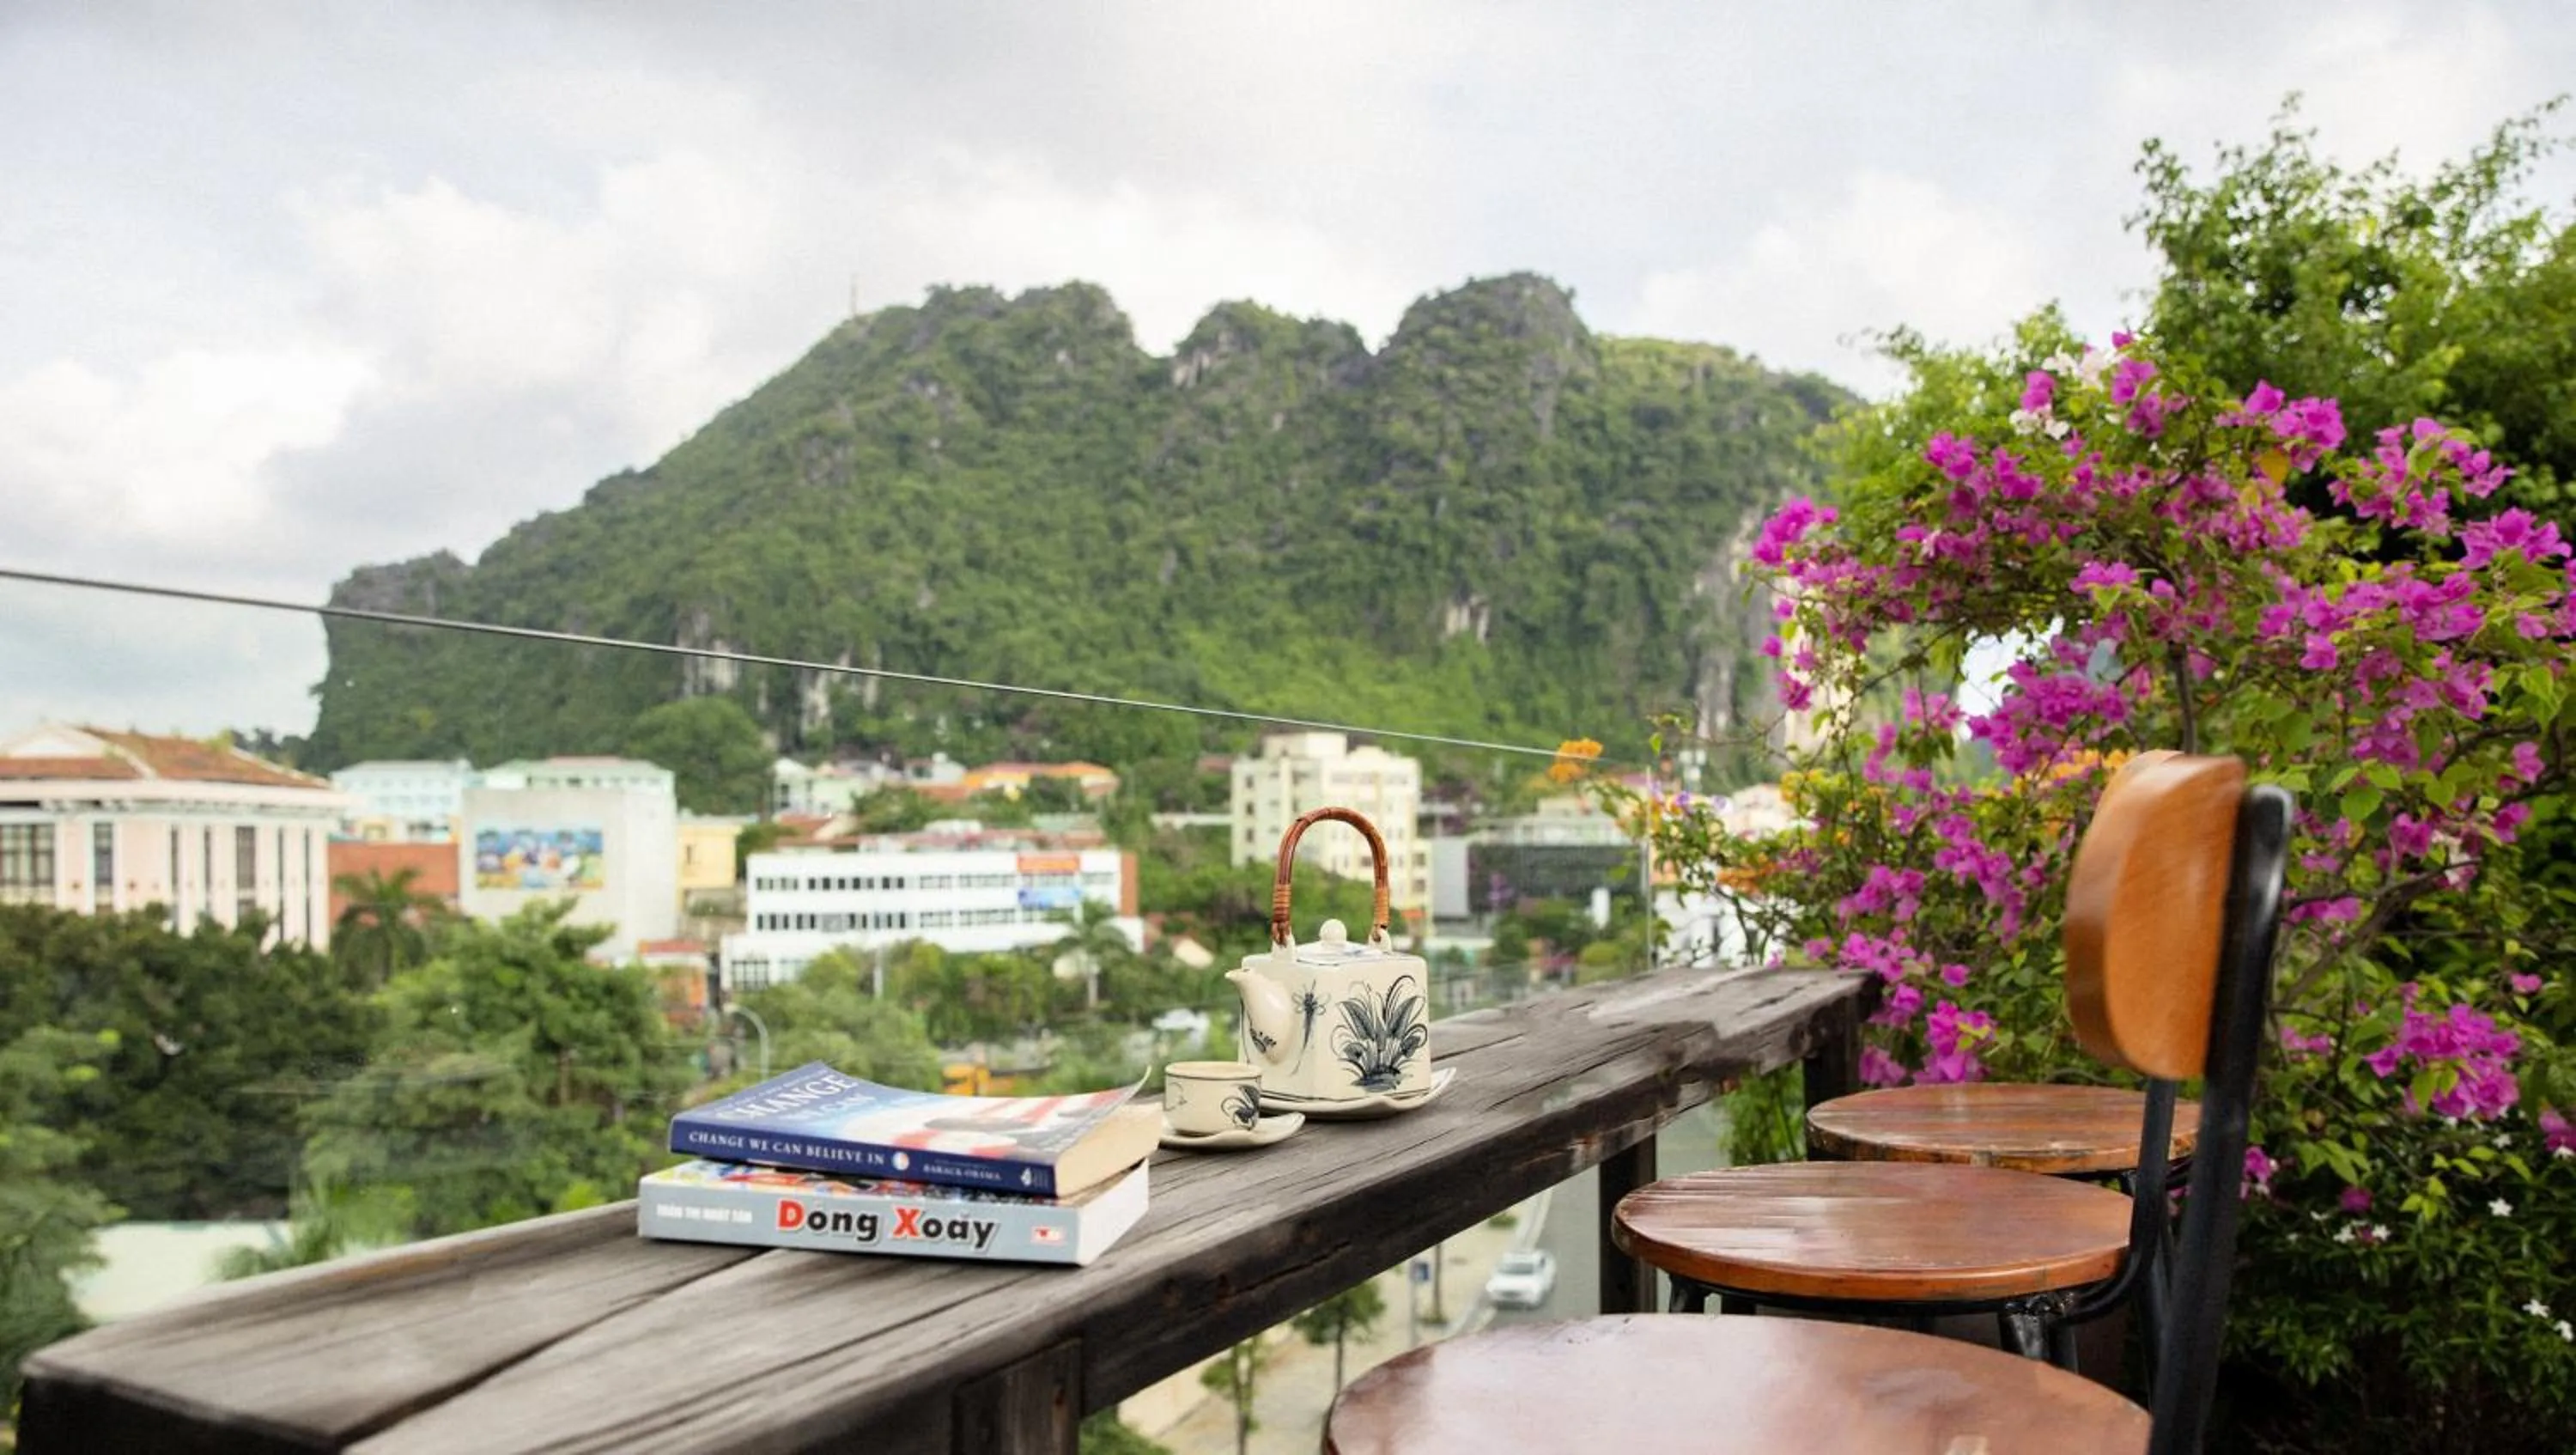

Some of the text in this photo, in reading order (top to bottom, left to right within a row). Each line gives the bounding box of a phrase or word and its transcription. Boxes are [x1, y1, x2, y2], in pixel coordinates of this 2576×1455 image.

[689, 1130, 884, 1166] CHANGE WE CAN BELIEVE IN
